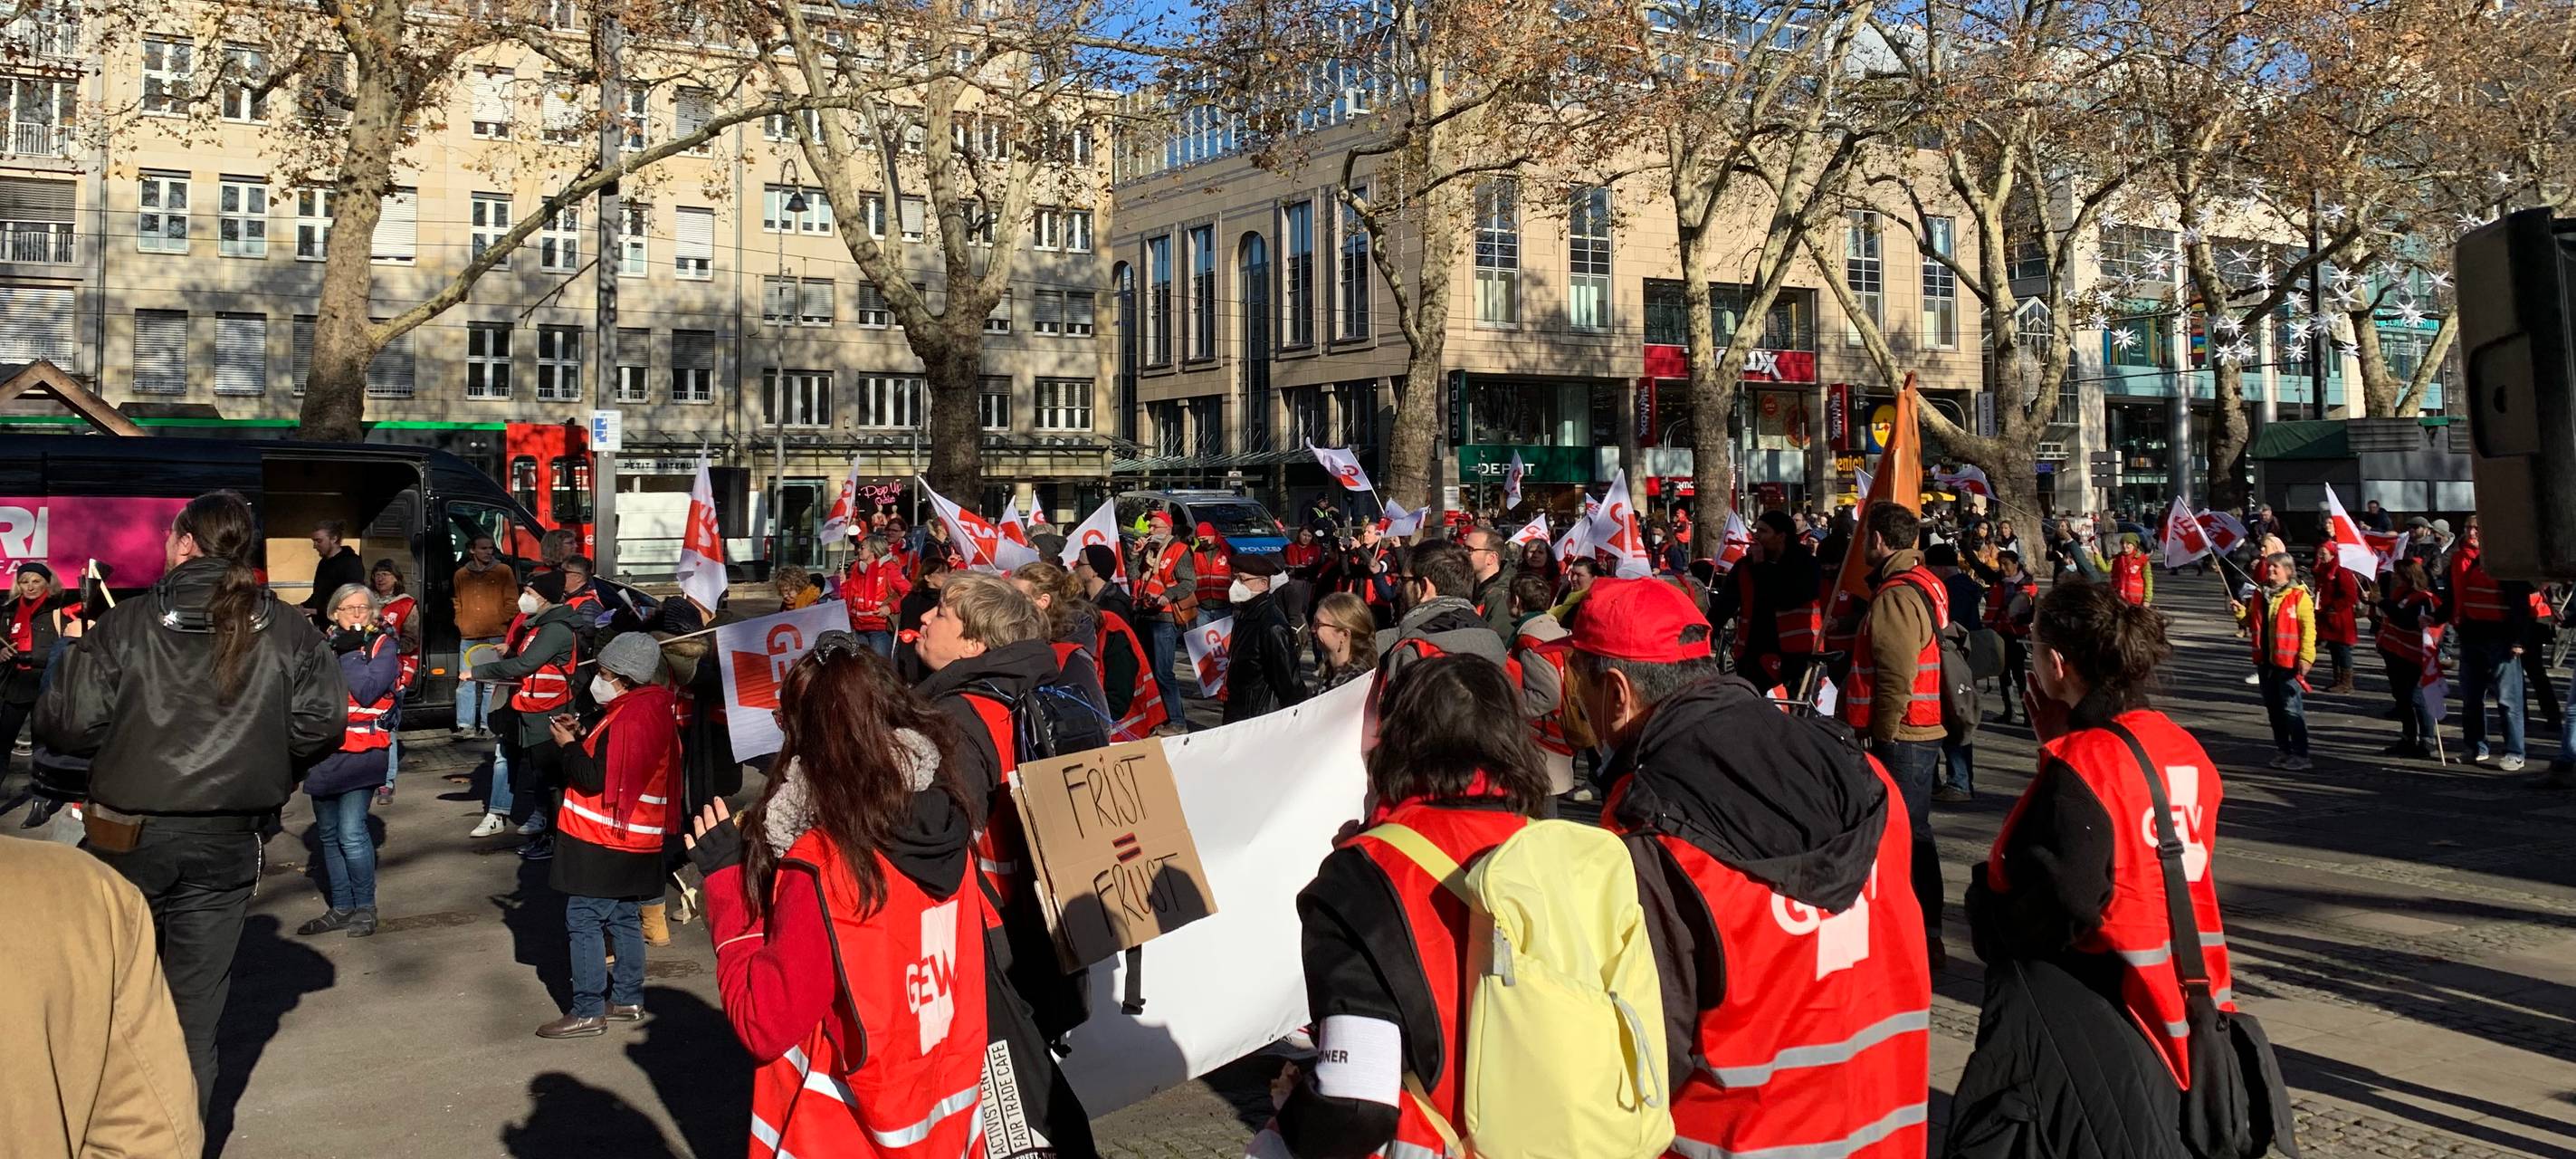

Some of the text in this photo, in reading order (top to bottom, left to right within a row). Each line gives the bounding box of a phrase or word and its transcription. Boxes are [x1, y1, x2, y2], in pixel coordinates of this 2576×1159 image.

[1451, 376, 1460, 440] DEPOT
[624, 462, 692, 470] PETIT BATEAU
[861, 485, 889, 502] Pop
[889, 481, 902, 494] Up
[1477, 463, 1536, 475] DEPT
[1238, 545, 1283, 553] POLIZEI
[1092, 852, 1178, 938] FRUST
[906, 950, 959, 1015] GEW
[991, 1043, 1028, 1149] FAIR TRADE CAFE
[983, 1102, 1007, 1156] ACTIVIST
